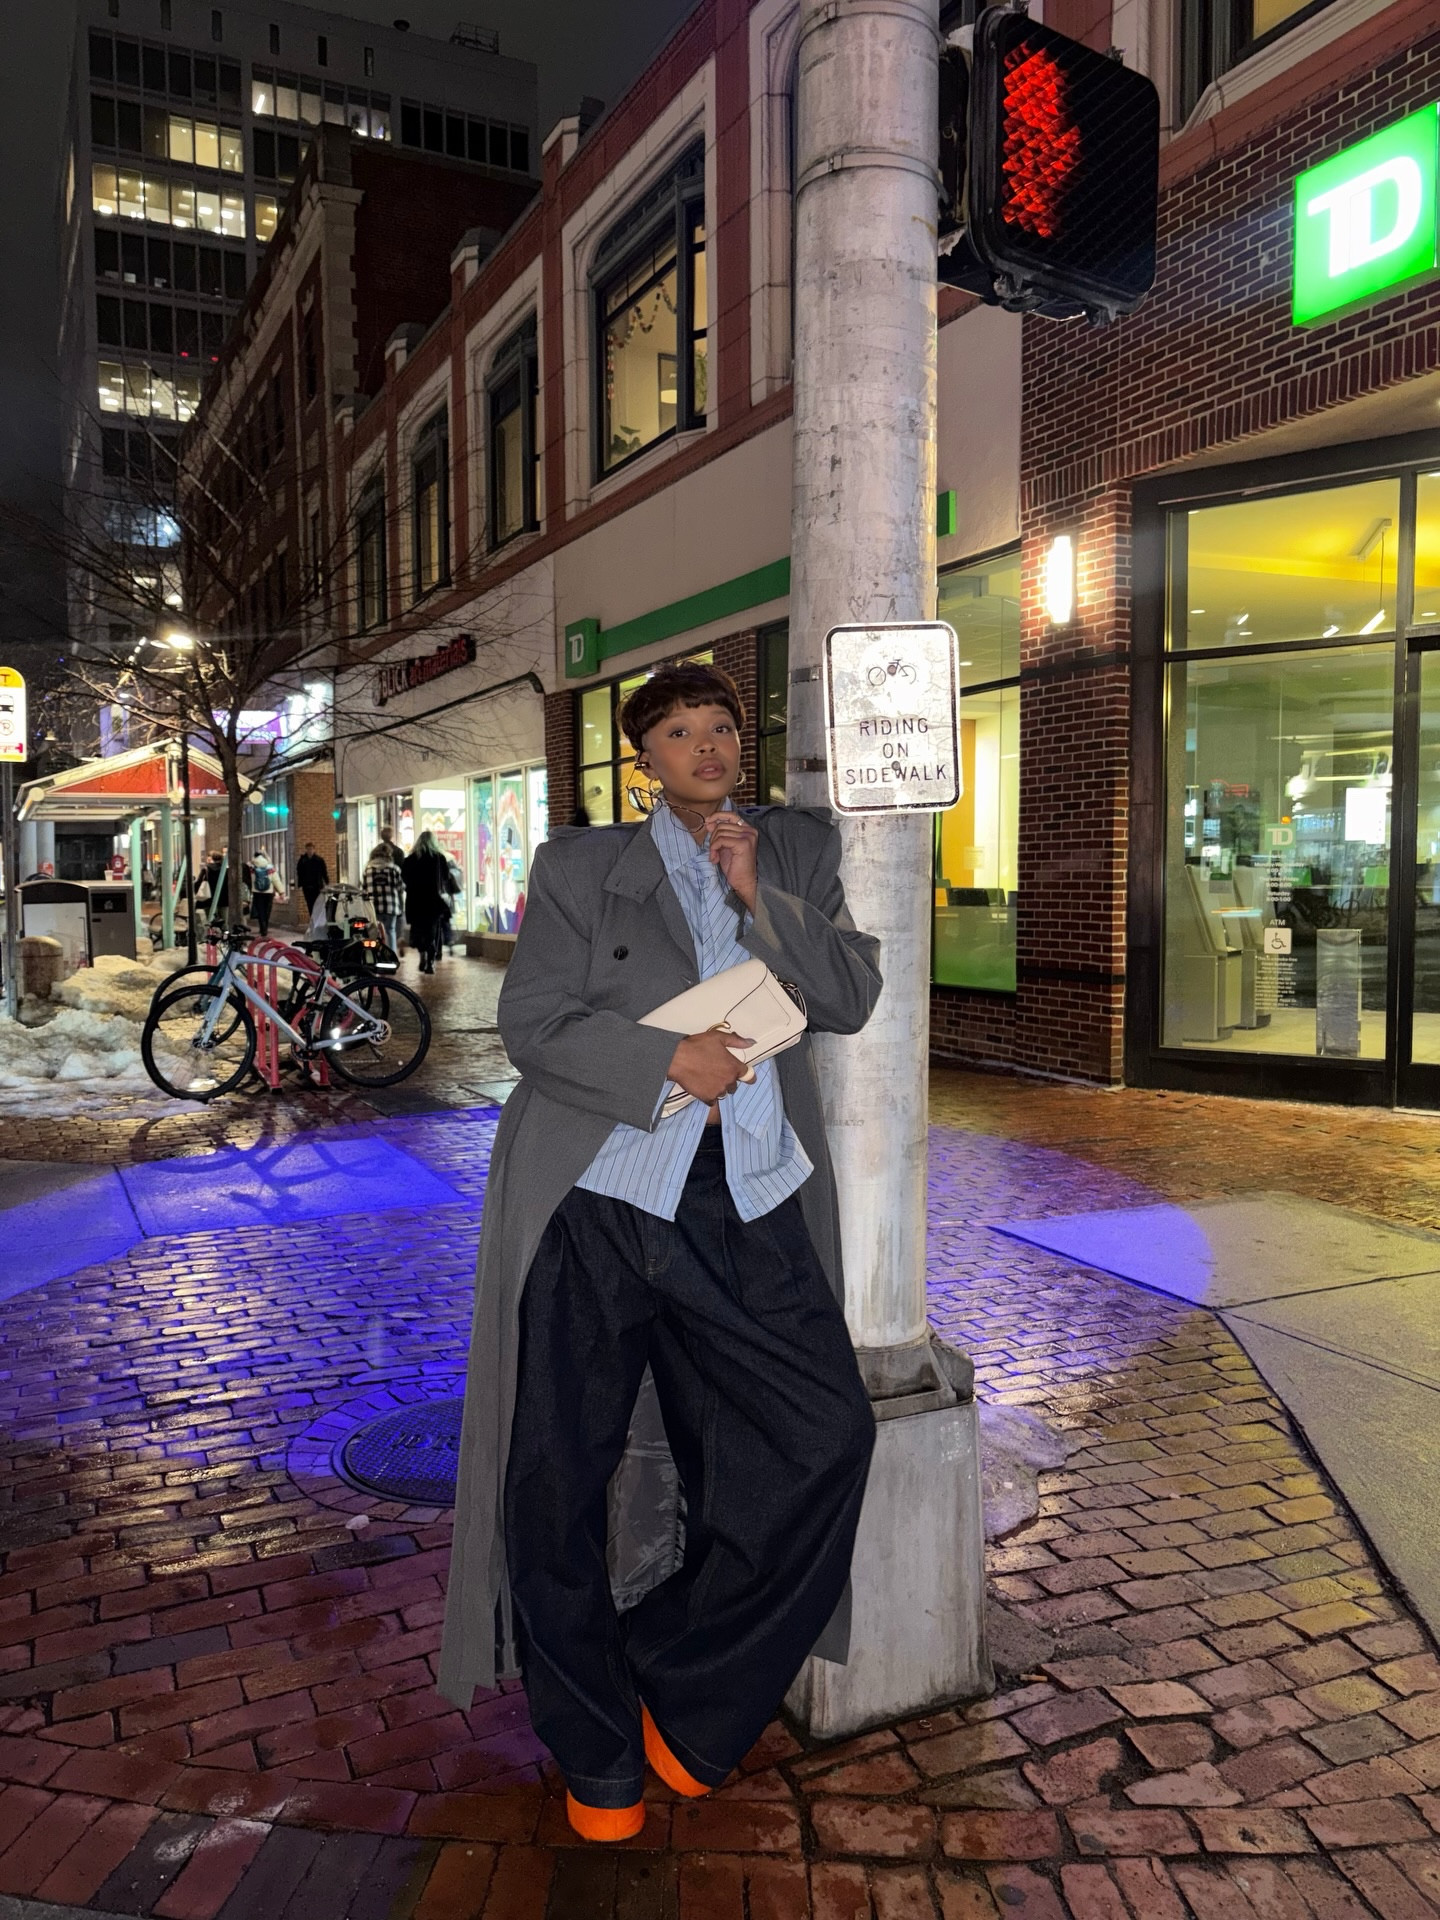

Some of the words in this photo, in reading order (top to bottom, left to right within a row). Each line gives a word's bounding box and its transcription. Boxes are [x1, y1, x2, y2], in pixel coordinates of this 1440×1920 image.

[1308, 156, 1422, 278] TD
[569, 633, 584, 664] TD
[859, 717, 928, 736] RIDING
[882, 742, 908, 759] ON
[845, 764, 946, 785] SIDEWALK
[1267, 828, 1293, 846] TD
